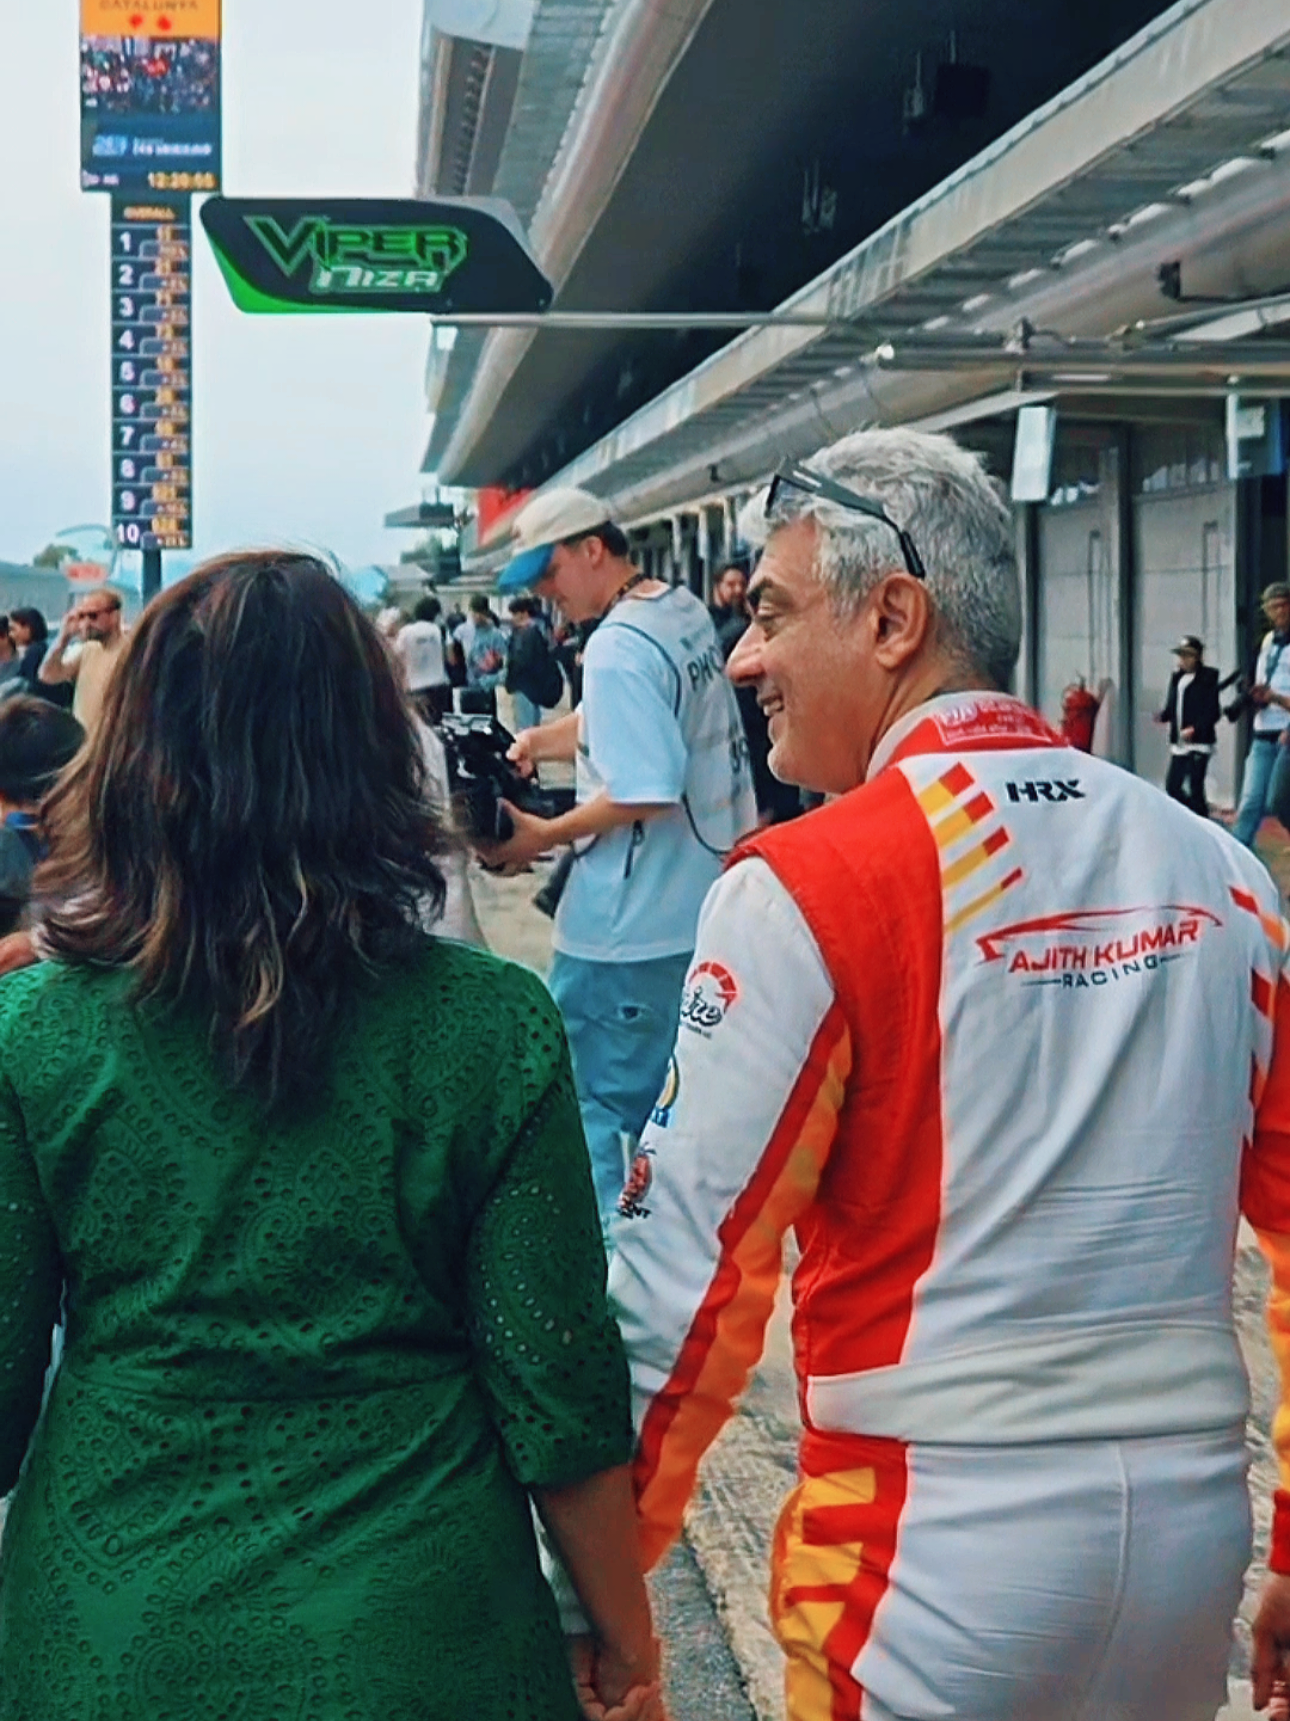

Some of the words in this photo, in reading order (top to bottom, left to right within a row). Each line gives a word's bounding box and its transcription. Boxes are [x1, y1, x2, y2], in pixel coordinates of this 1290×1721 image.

[120, 231, 131, 252] 1
[243, 214, 468, 278] VIPER
[119, 264, 133, 285] 2
[119, 297, 133, 317] 3
[119, 329, 134, 350] 4
[120, 361, 135, 381] 5
[120, 394, 135, 414] 6
[120, 426, 135, 446] 7
[121, 458, 135, 479] 8
[121, 490, 136, 511] 9
[117, 523, 140, 544] 10
[1006, 779, 1086, 802] HRX
[1008, 948, 1087, 973] AJITH
[1094, 920, 1200, 966] KUMAR
[1062, 954, 1158, 988] RACING
